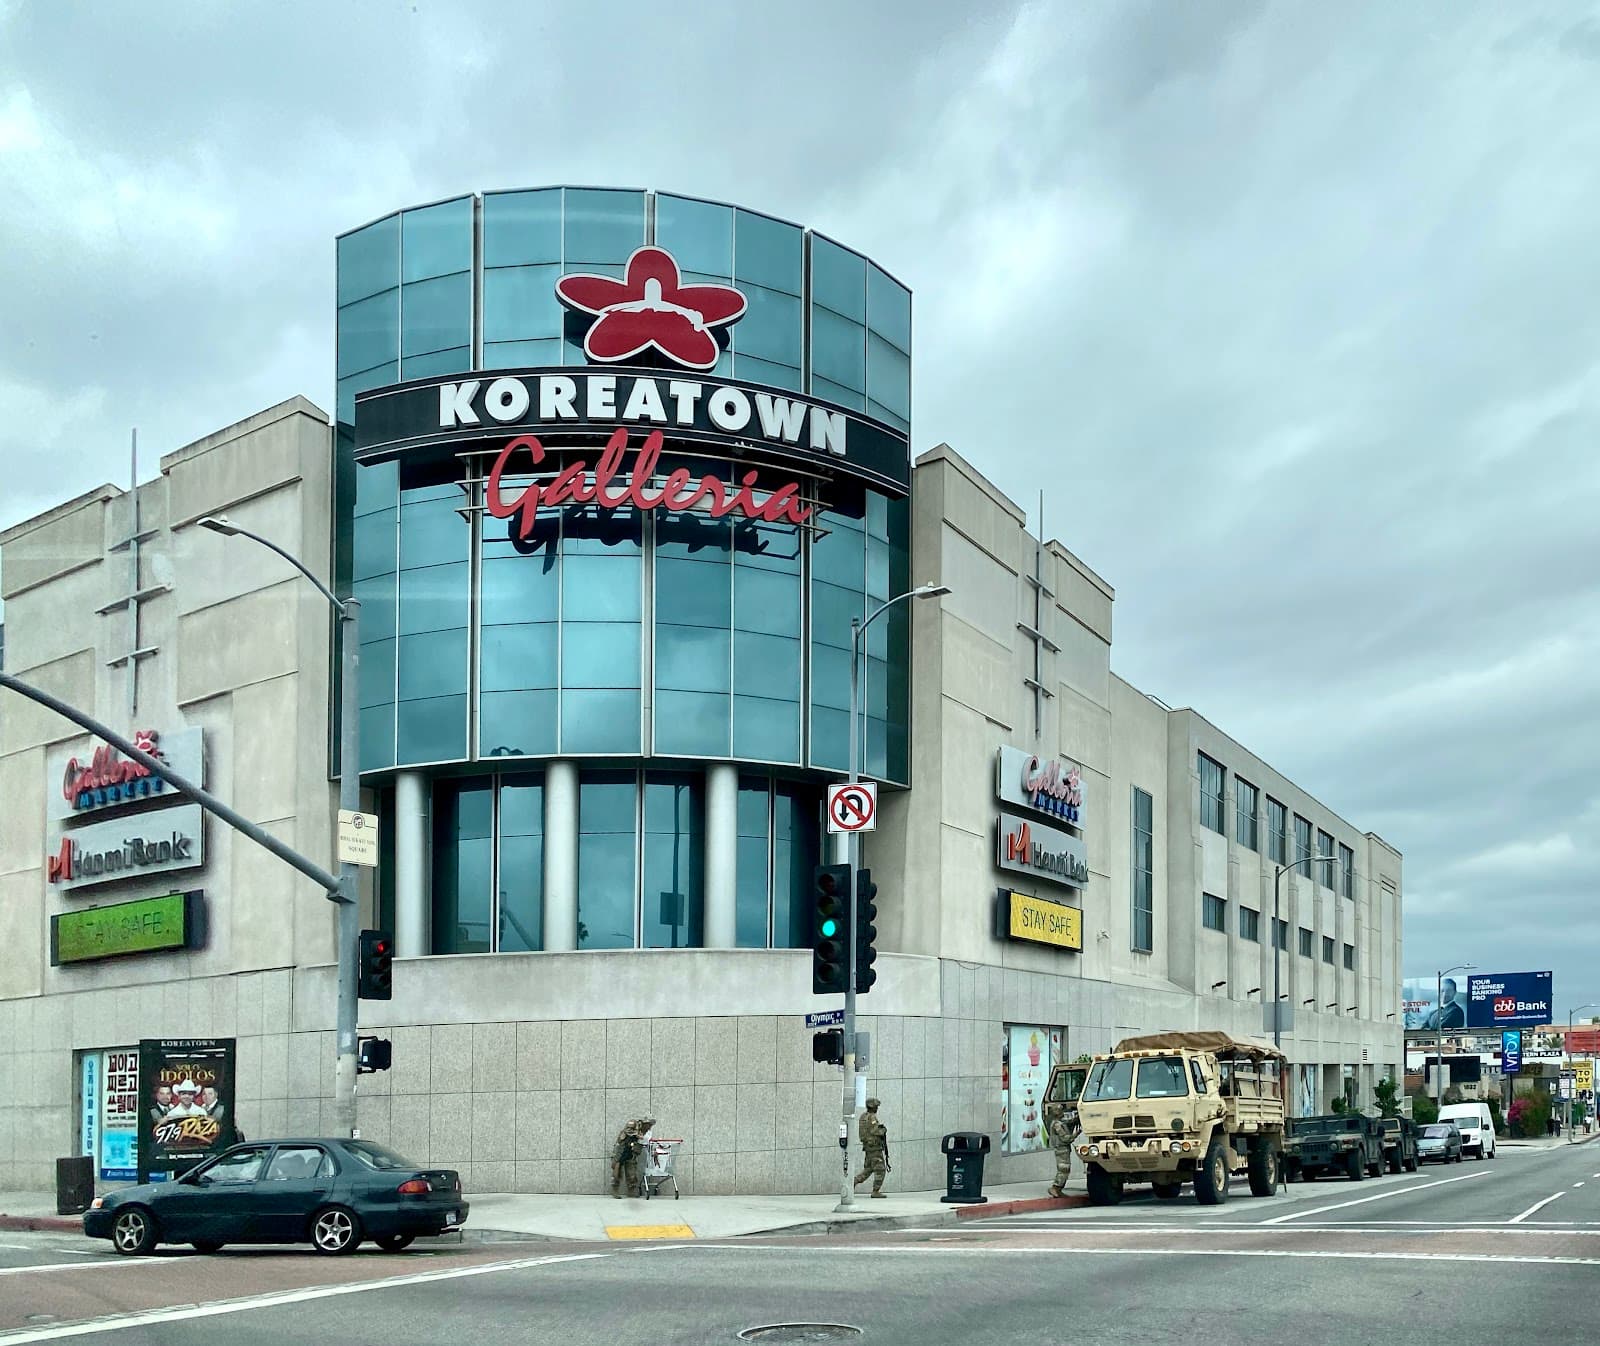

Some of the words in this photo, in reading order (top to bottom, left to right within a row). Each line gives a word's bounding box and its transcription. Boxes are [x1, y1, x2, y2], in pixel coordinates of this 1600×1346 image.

[438, 374, 848, 456] KOREATOWN
[485, 427, 812, 540] Galleria
[1022, 907, 1047, 930] STAY
[1471, 983, 1505, 991] BUSINESS
[1494, 999, 1516, 1012] cbb
[1516, 1001, 1547, 1011] Bank
[810, 1012, 835, 1024] Olympic
[155, 1123, 182, 1145] 97.9
[179, 1116, 217, 1143] RAZA
